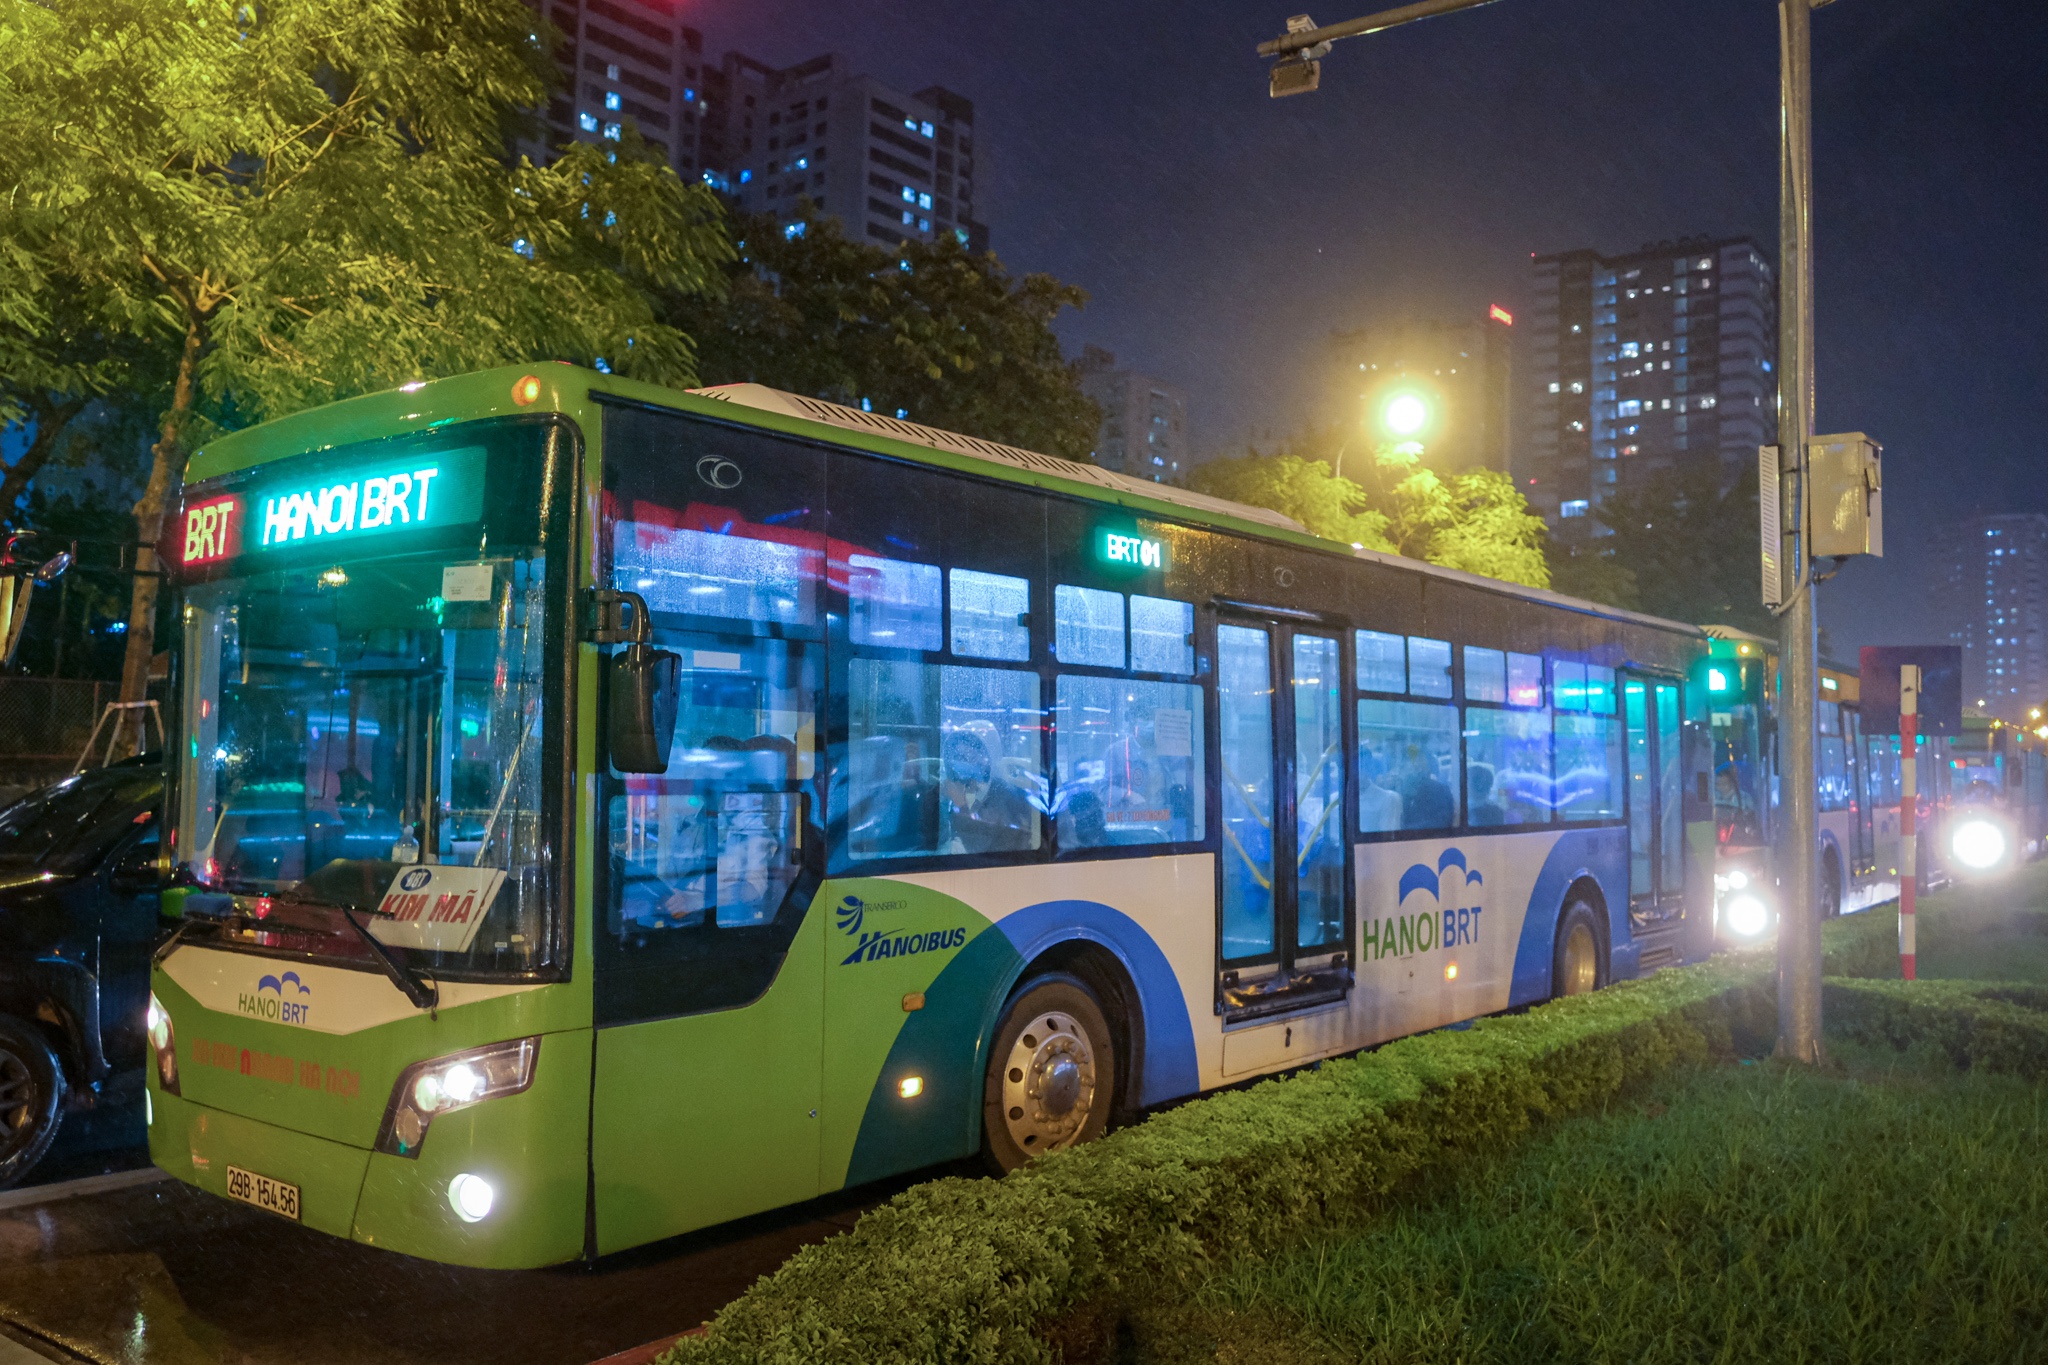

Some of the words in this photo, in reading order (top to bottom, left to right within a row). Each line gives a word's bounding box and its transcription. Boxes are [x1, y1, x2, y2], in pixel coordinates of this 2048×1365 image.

[262, 481, 358, 545] HANOI
[359, 467, 438, 531] BRT
[184, 501, 234, 562] BRT
[375, 893, 430, 922] KIM
[428, 889, 478, 924] MÃ
[1443, 906, 1482, 948] BRT
[840, 927, 966, 967] HANOIBUS
[282, 1001, 309, 1024] BRT
